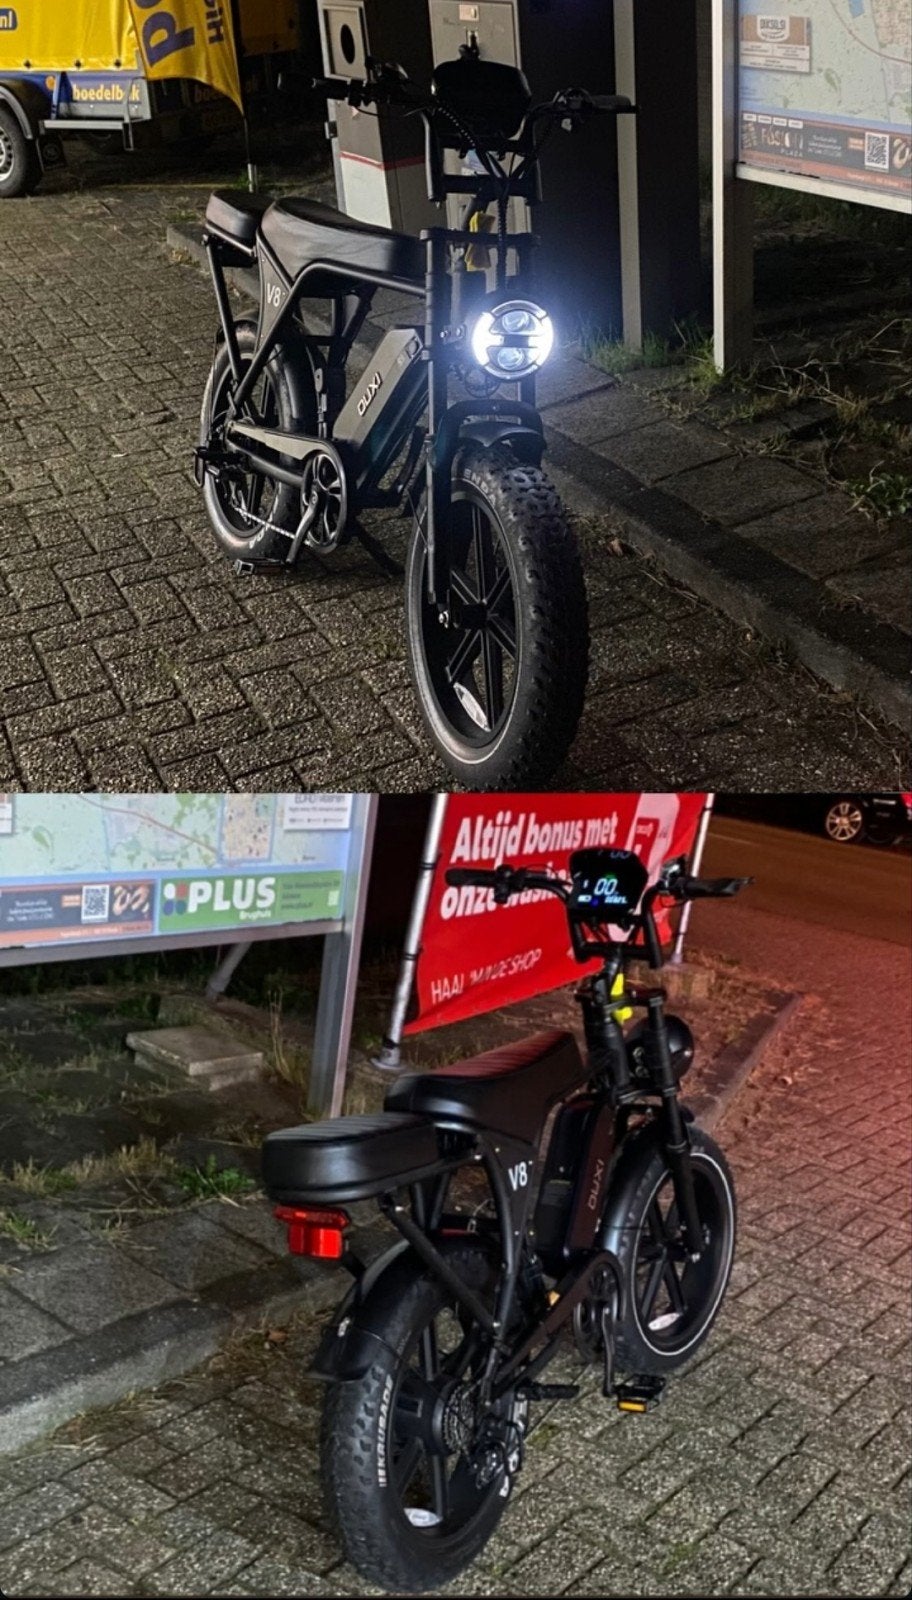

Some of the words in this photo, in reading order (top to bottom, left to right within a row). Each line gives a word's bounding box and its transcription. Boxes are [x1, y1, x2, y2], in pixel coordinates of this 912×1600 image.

[72, 84, 140, 101] boedelbk
[267, 283, 282, 307] V8
[357, 372, 384, 417] OUXI
[450, 811, 526, 869] Altijd
[523, 812, 583, 855] bonus
[583, 811, 618, 848] met
[187, 877, 276, 913] PLUS
[508, 1161, 528, 1191] V8
